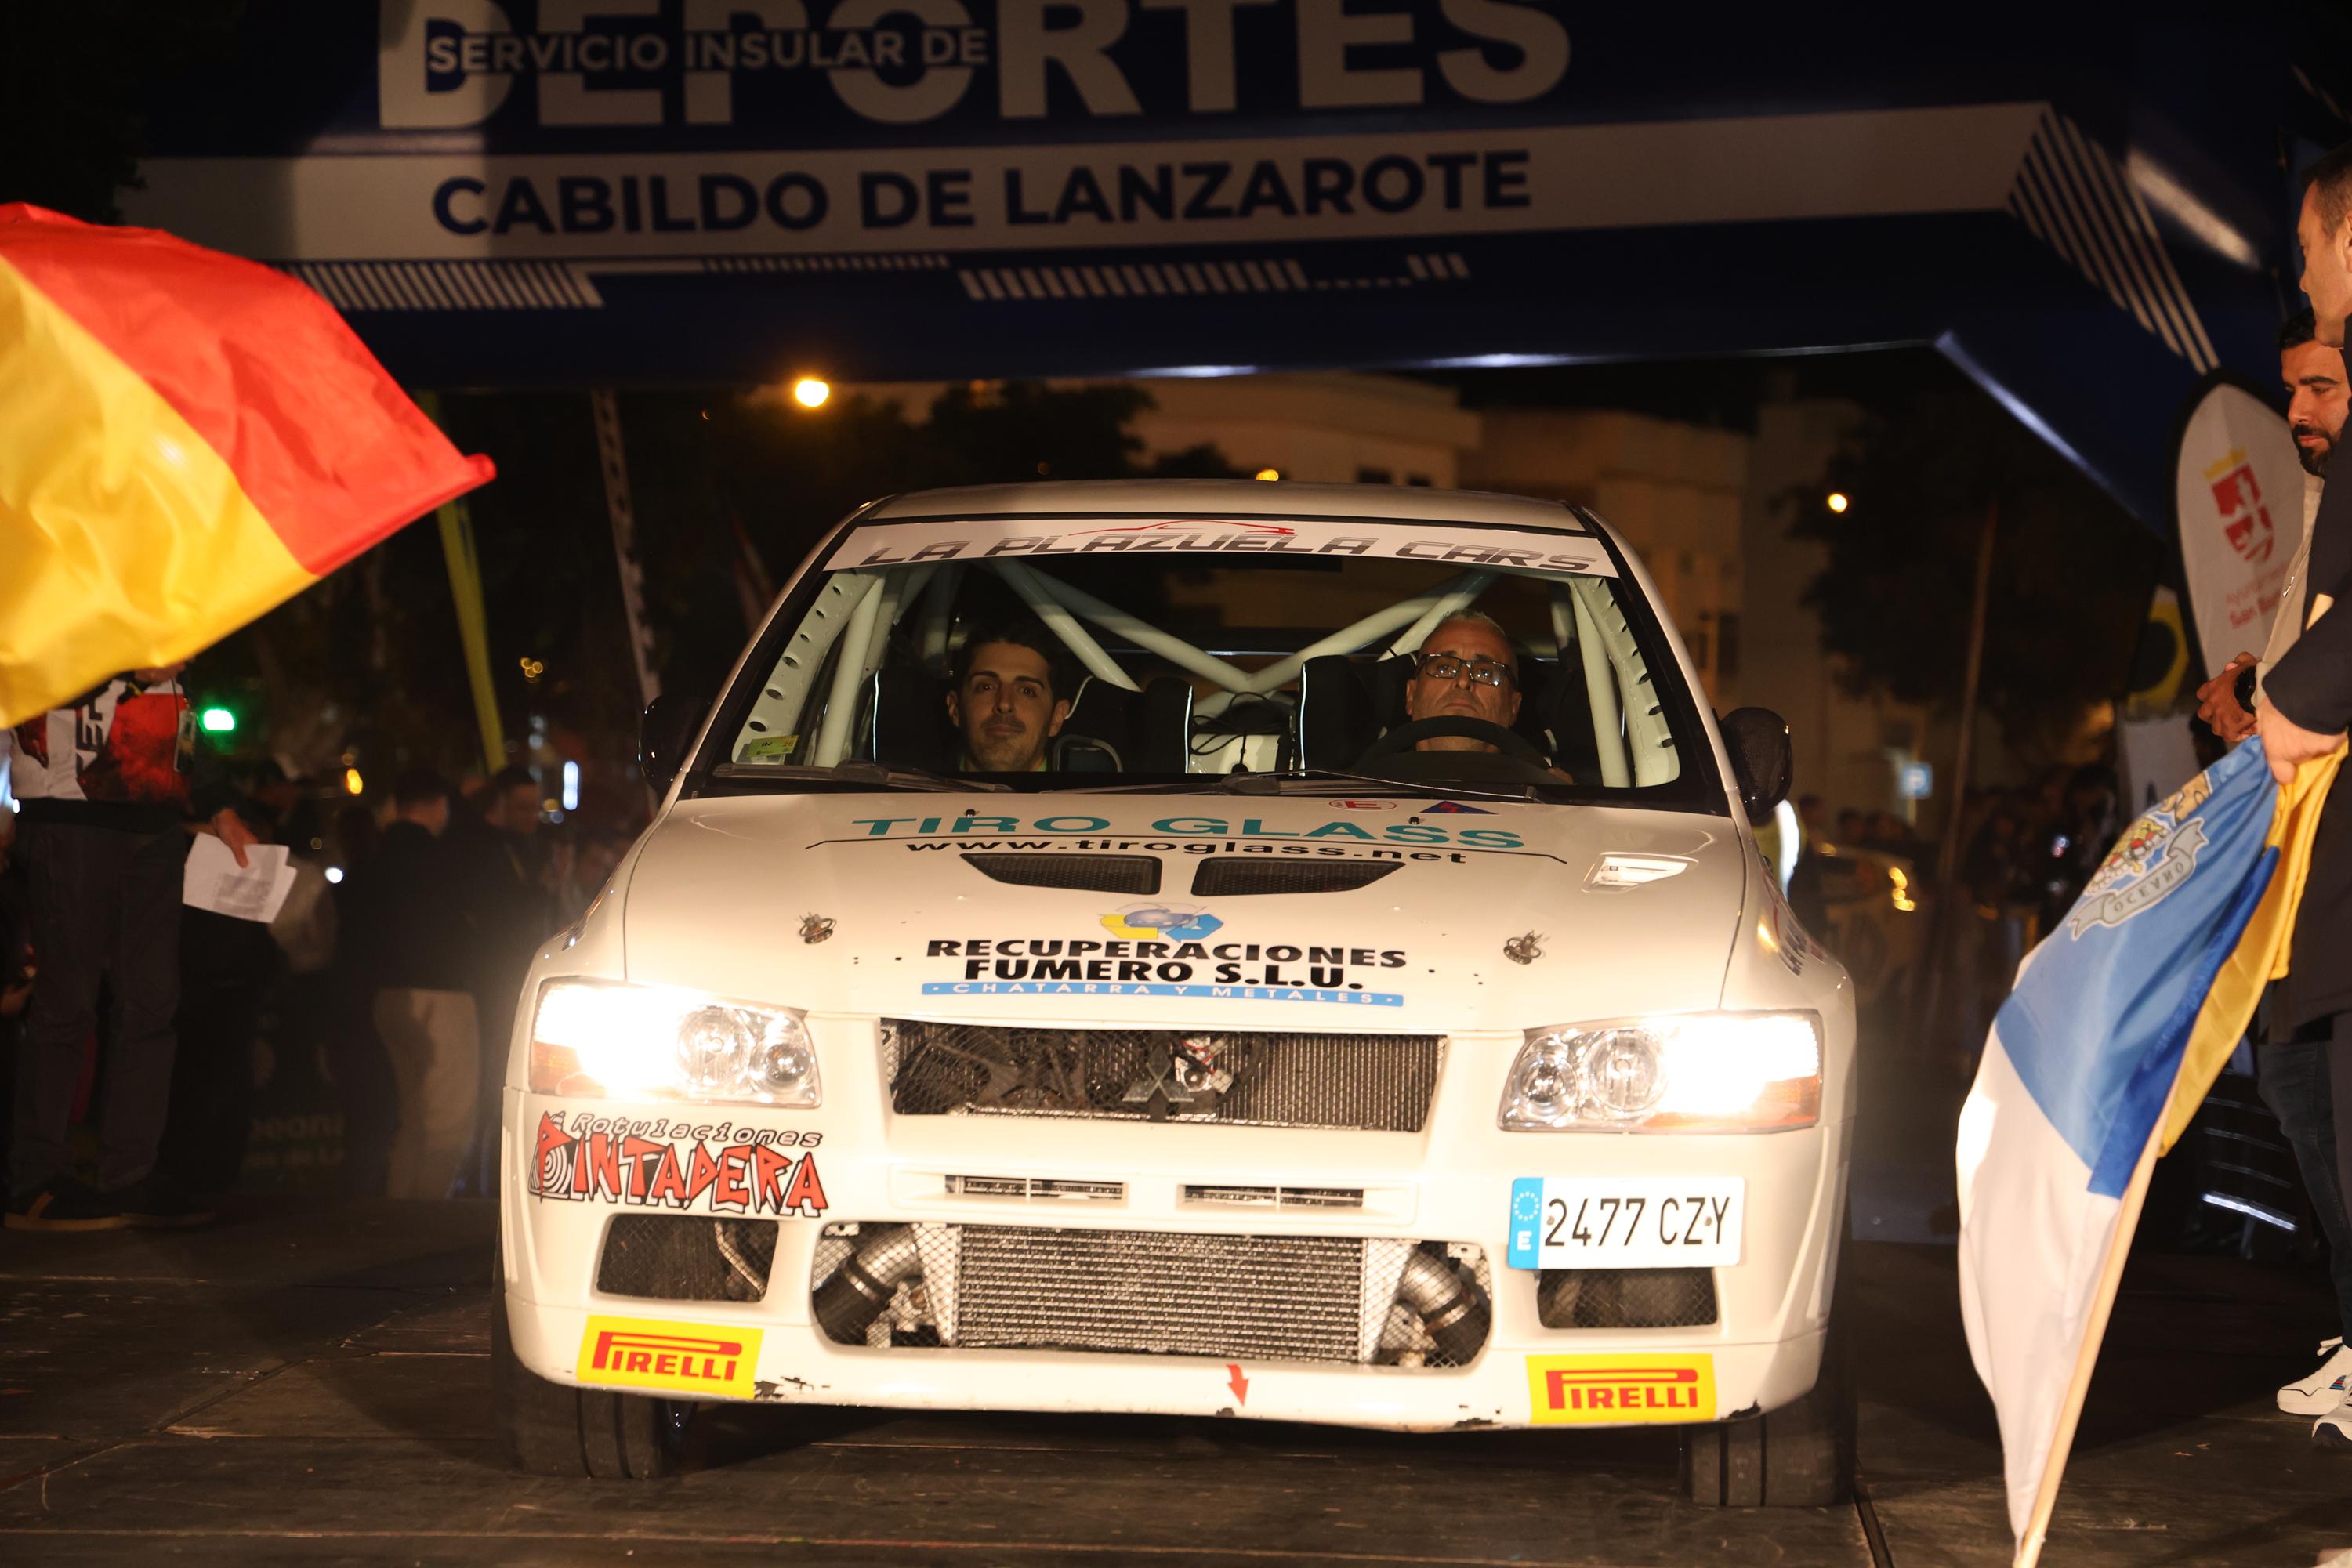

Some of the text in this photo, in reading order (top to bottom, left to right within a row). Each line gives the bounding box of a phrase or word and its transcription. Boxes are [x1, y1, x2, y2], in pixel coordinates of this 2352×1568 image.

[379, 0, 1571, 130] DEPORTES
[427, 28, 989, 74] SERVICIO INSULAR DE
[433, 150, 1532, 235] CABILDO DE LANZAROTE
[859, 532, 1600, 570] LA PLAZUELA CARS
[852, 817, 1524, 849] TIRO GLASS
[906, 839, 1466, 864] www.tiroglass.net
[926, 940, 1407, 969] RECUPERACIONES
[953, 983, 1372, 1003] CHATARRA Y METALES
[965, 959, 1364, 990] FUMERO S.L.U.
[571, 1113, 823, 1147] Rotulaciones
[528, 1111, 829, 1217] PINTADERA
[1517, 1231, 1532, 1251] E
[1545, 1197, 1730, 1247] 2477 CZY
[592, 1331, 742, 1381] PIRELLI
[1546, 1369, 1698, 1410] PIRELLI
